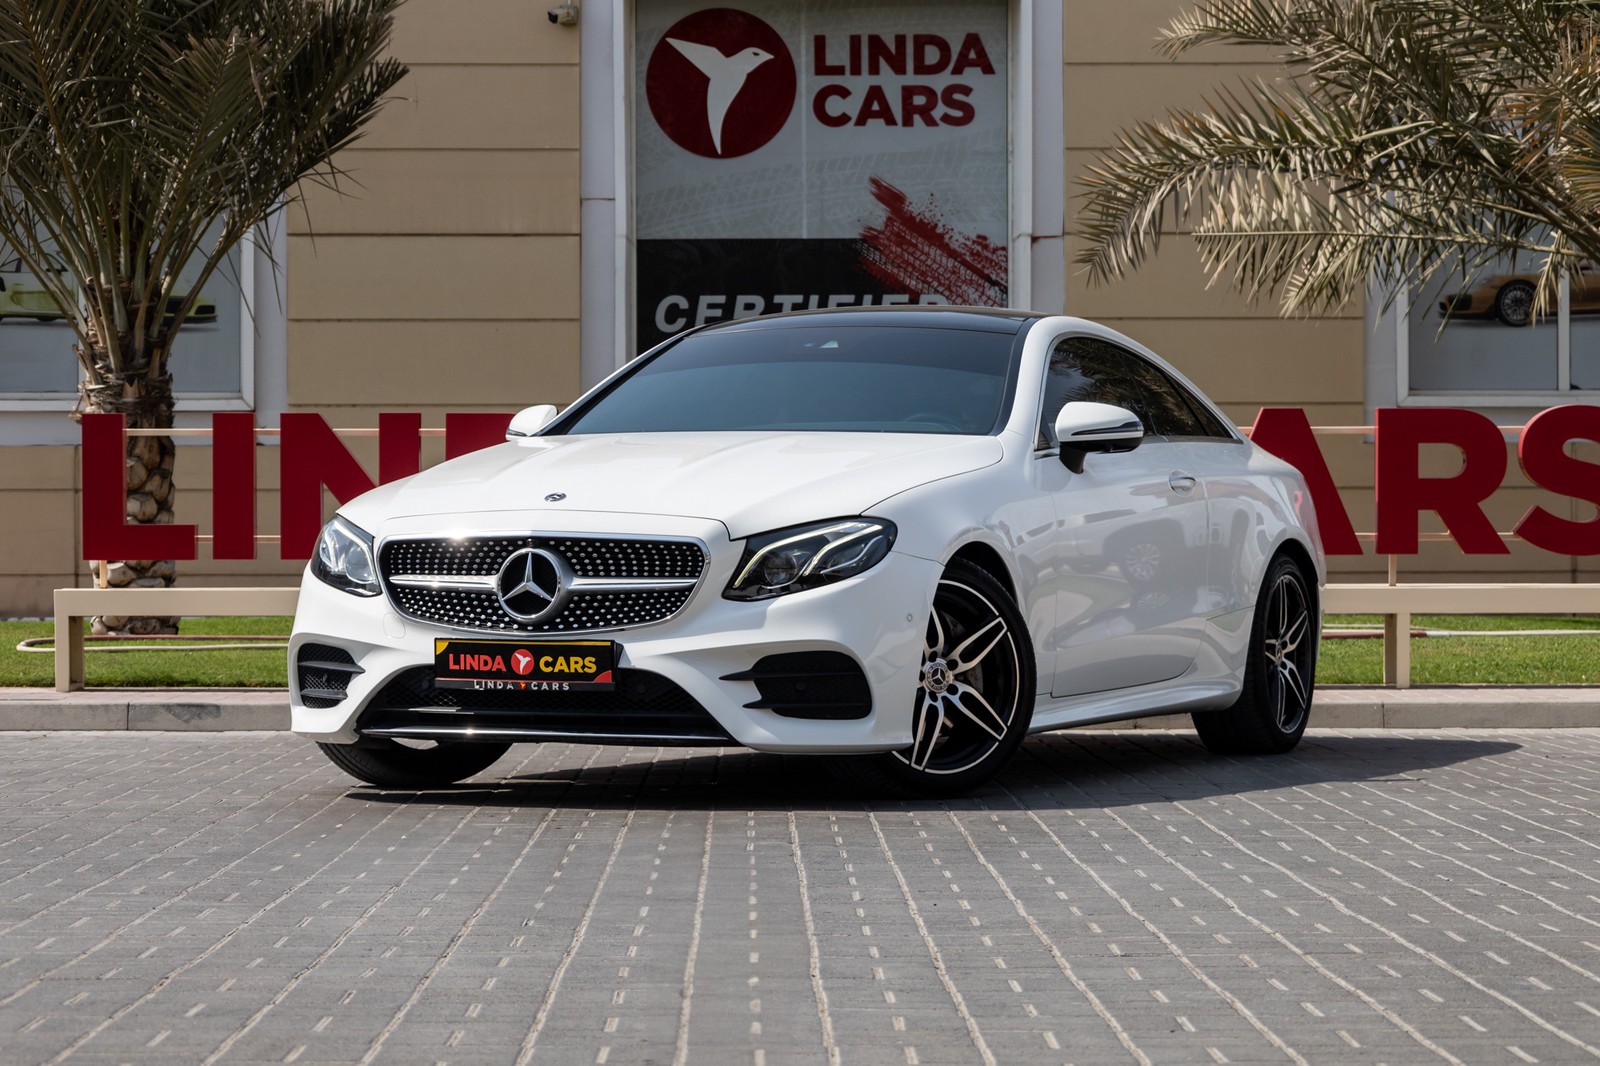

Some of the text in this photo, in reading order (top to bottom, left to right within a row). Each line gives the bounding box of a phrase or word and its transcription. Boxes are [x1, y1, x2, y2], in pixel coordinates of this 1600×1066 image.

[813, 33, 995, 76] LINDA
[812, 84, 976, 127] CARS
[449, 653, 597, 673] LINDA CARS
[474, 679, 570, 691] LINDA CARS
